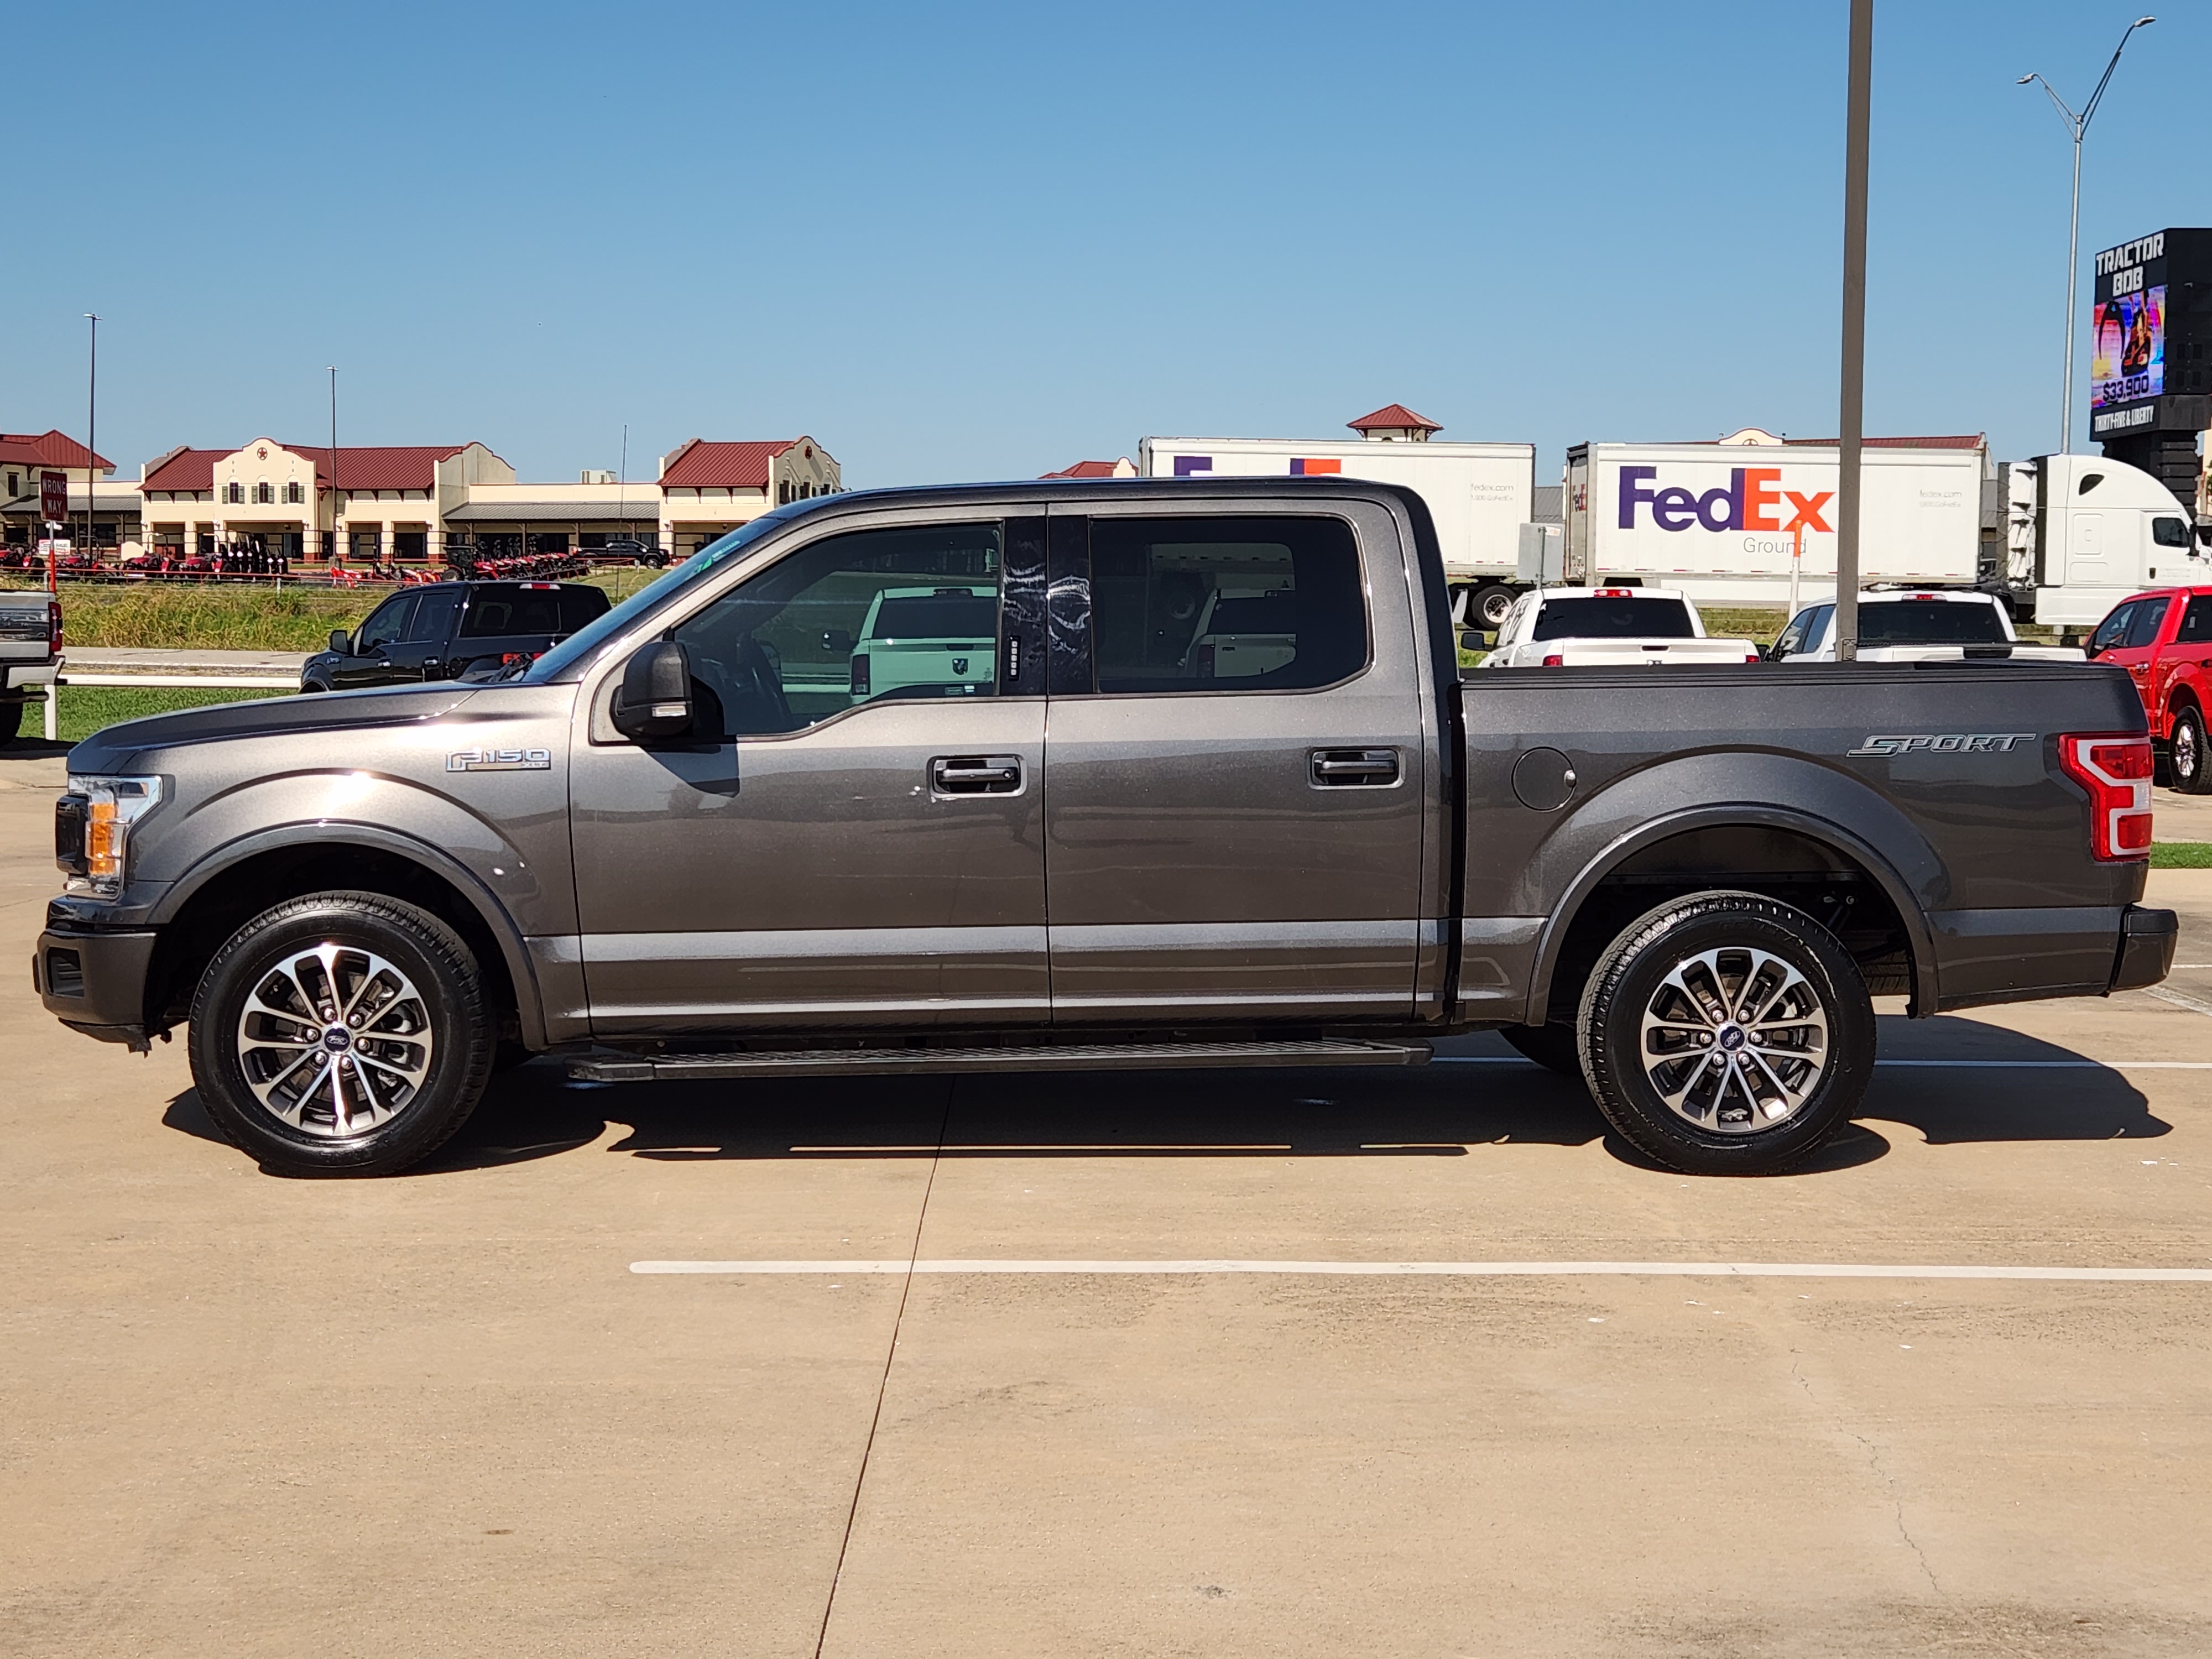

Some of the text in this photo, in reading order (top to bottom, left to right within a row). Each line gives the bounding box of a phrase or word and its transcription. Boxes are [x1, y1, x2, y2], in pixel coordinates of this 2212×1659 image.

[2096, 232, 2164, 276] TRACTOR
[2112, 265, 2143, 297] BOB
[2103, 375, 2149, 403] $33,900
[42, 478, 66, 495] WRONG
[1618, 466, 1837, 533] FedEx
[46, 499, 62, 514] WAY
[1743, 537, 1807, 554] Ground
[1845, 733, 2037, 757] SPORT
